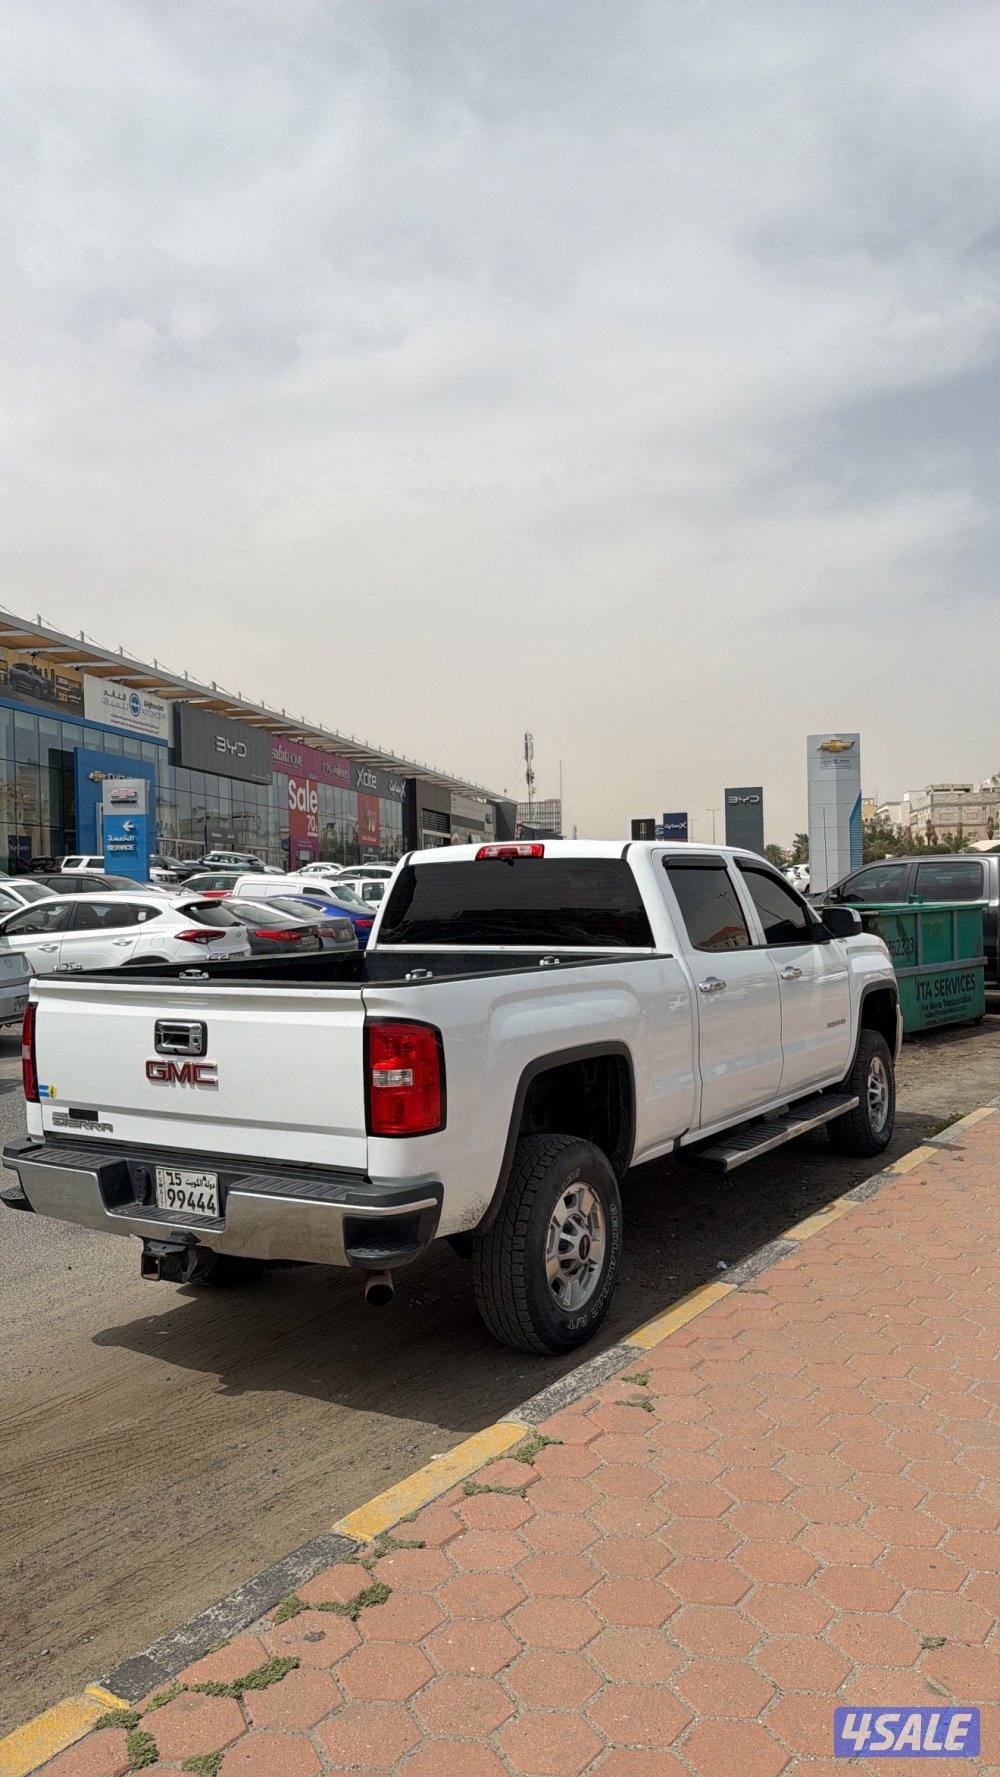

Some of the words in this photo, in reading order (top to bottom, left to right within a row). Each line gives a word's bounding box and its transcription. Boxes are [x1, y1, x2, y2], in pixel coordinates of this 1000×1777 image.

[216, 735, 247, 757] BYD
[288, 779, 319, 814] Sale
[728, 795, 760, 804] BYD
[934, 974, 976, 998] SERVICES
[145, 1060, 218, 1085] GMC
[52, 1117, 114, 1133] SIERRA
[166, 1171, 182, 1186] 15
[167, 1188, 216, 1214] 99444
